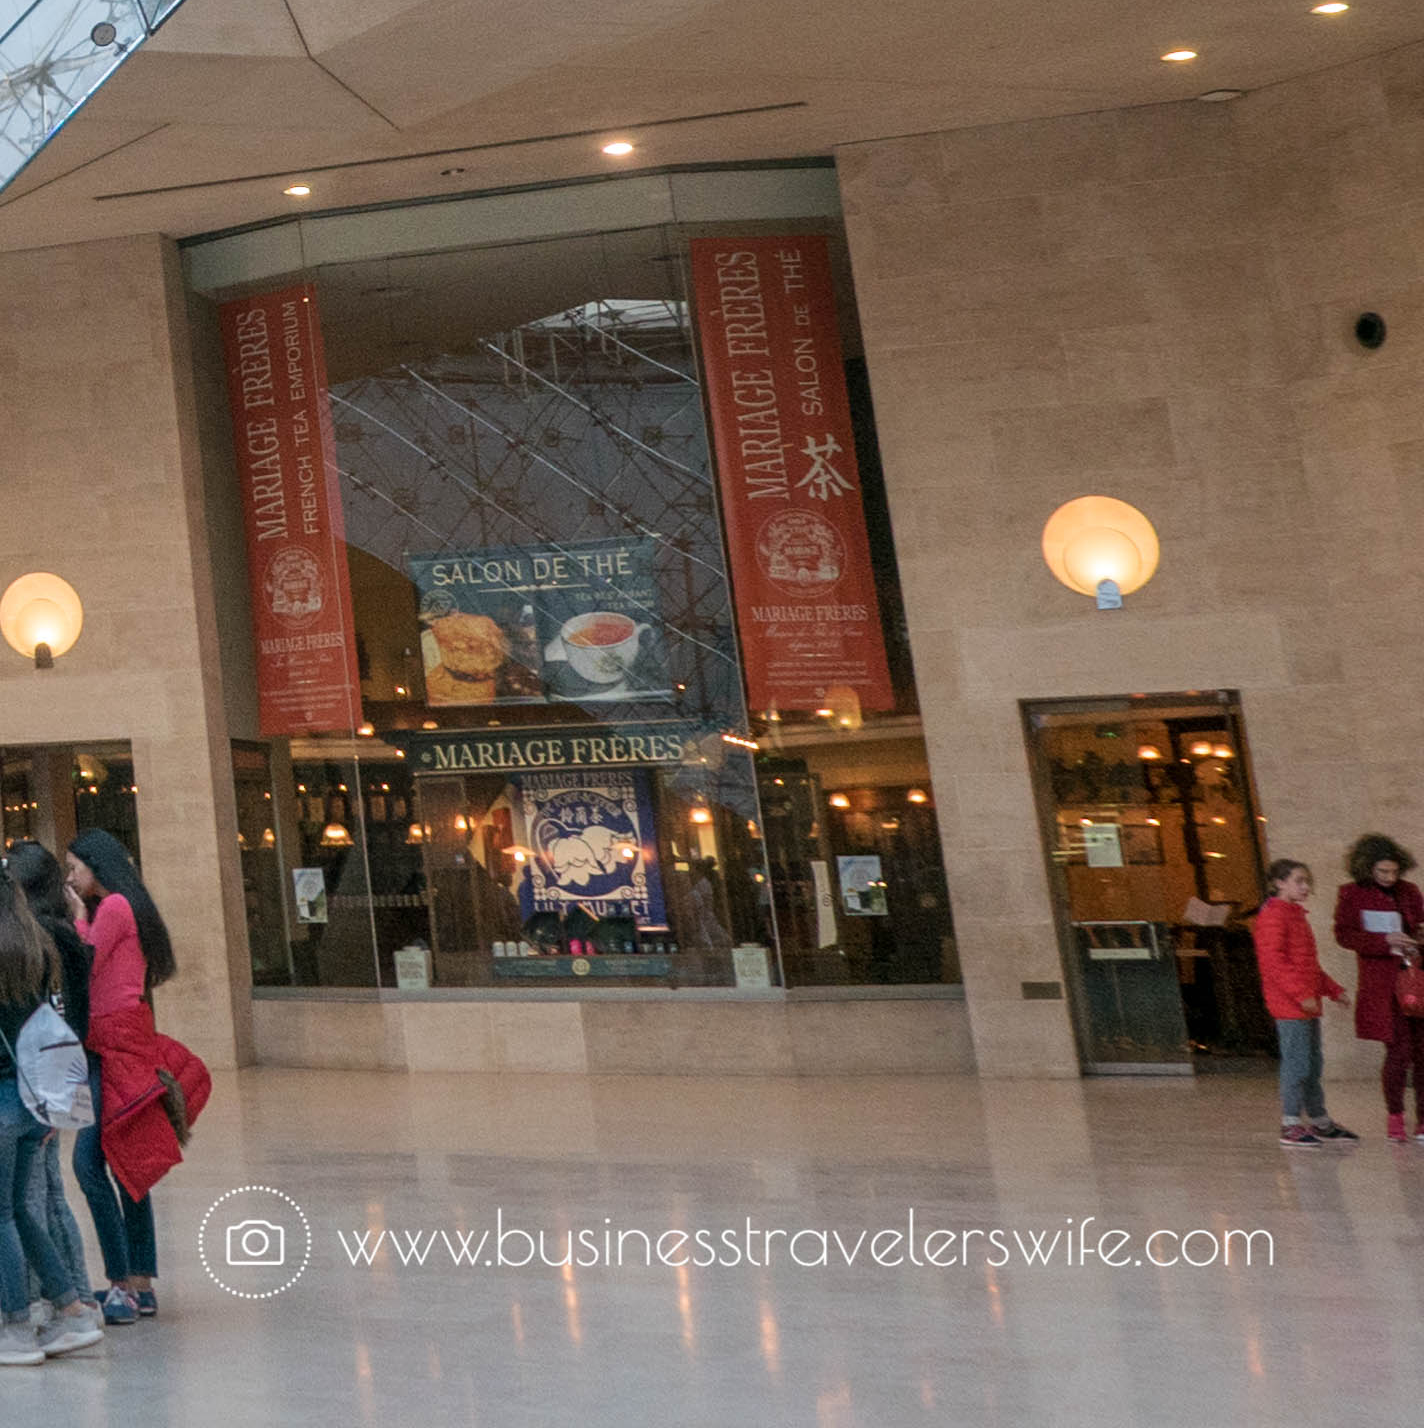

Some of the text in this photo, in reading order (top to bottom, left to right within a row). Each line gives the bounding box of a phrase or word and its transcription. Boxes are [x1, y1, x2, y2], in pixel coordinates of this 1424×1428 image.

[709, 251, 791, 500] MARIAGE FRÈRES
[775, 249, 824, 416] SALON DE THÉ
[232, 307, 289, 542] MARIAGE FRÈRES
[282, 300, 320, 535] FRENCH TEA EMPORIUM
[794, 433, 856, 502] 茶
[432, 546, 634, 586] SALON DE THÉ
[751, 606, 814, 623] MARIAGE
[433, 733, 685, 770] MARIAGE FRÈRES
